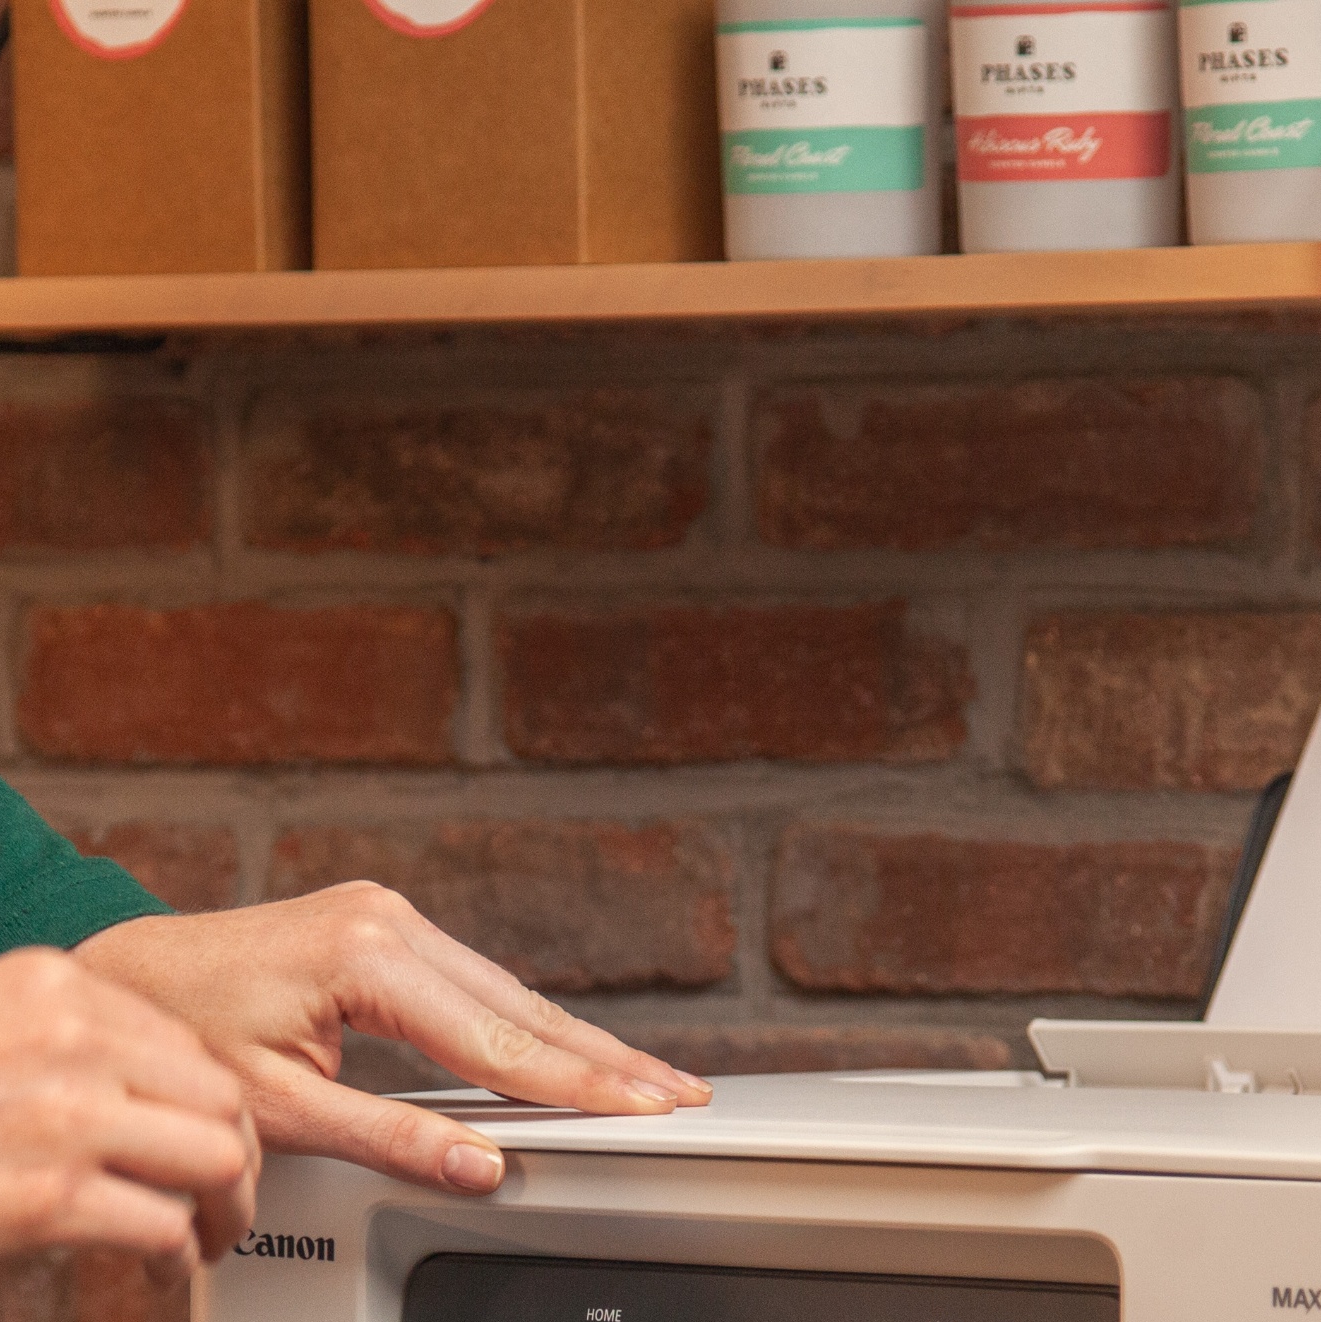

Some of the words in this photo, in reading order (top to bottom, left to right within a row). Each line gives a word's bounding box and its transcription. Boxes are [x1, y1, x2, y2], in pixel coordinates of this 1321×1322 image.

[1198, 47, 1289, 72] PHASES
[980, 62, 1076, 82] PHASES
[738, 76, 827, 97] PHASES
[1043, 126, 1103, 165] Ruby
[586, 1308, 622, 1322] HOME
